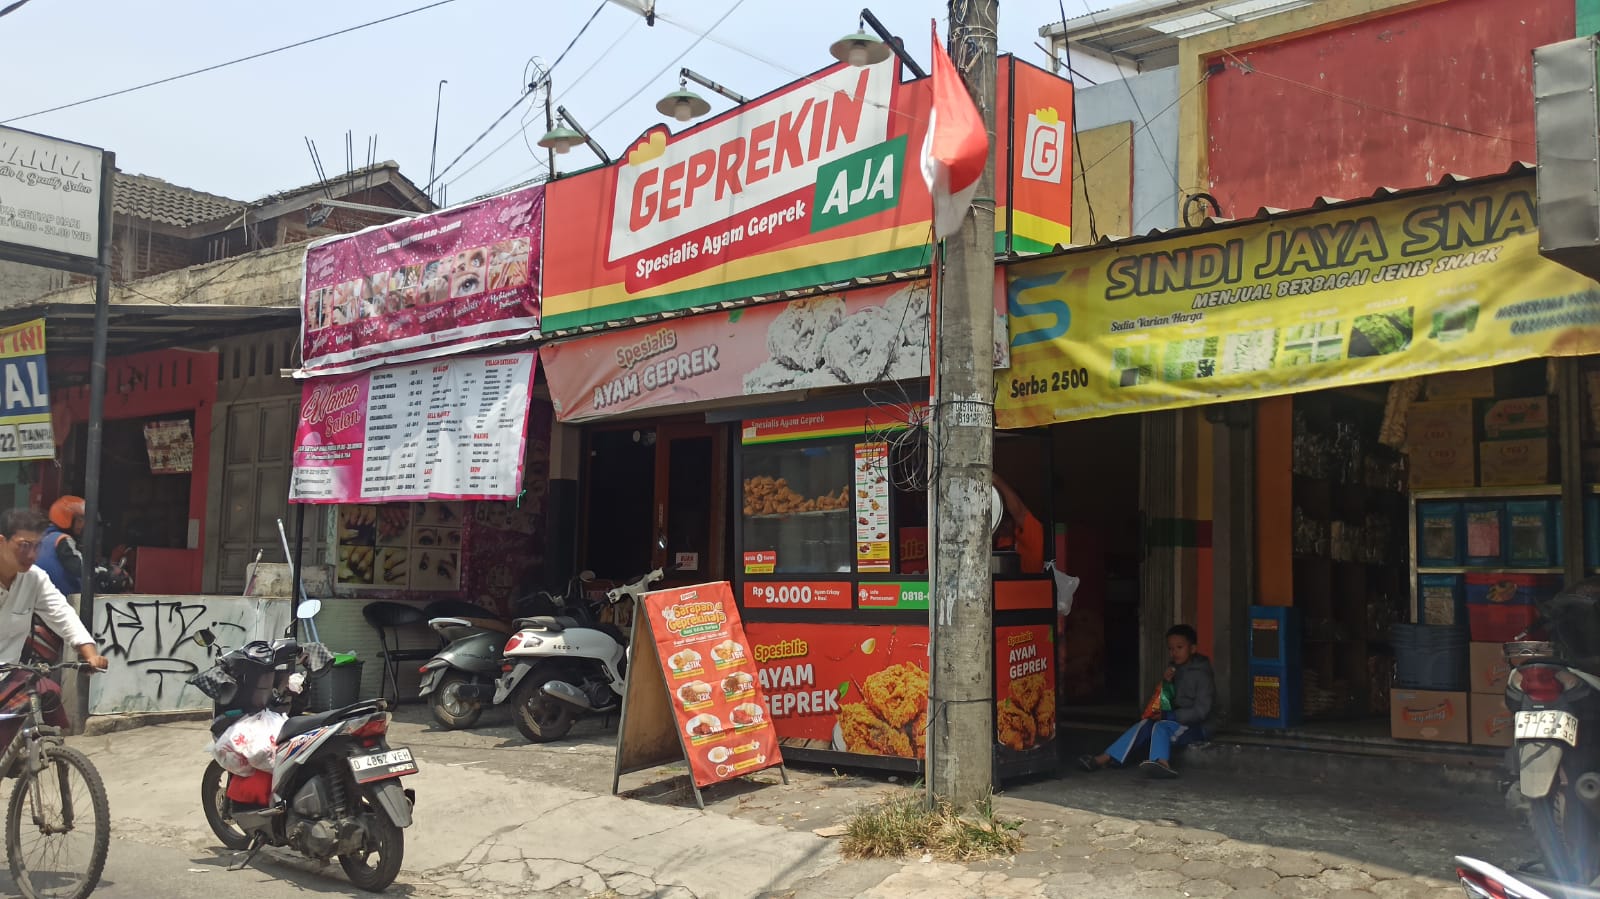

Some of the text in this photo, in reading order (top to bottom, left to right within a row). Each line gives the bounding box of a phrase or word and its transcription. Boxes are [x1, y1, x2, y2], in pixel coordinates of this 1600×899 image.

[629, 69, 870, 232] GEPREKIN
[821, 154, 894, 215] AJA
[635, 200, 806, 279] Spesialis Ayam Geprek
[1105, 190, 1540, 300] SINDI JAYA SNA
[1191, 246, 1503, 309] MENJUAL BERBAGAI JENIS SNACK
[1137, 316, 1169, 329] Varian
[1171, 311, 1203, 324] Harga
[616, 328, 677, 369] Spesialis
[0, 361, 48, 410] AL
[593, 344, 720, 409] AYAM GEPREK
[1010, 367, 1089, 398] Serba 2500
[325, 409, 361, 437] Salon
[779, 417, 799, 428] Ayam
[800, 413, 825, 425] Geprek
[752, 585, 812, 603] Rp 9.000
[673, 602, 713, 618] Sarapan
[754, 639, 808, 662] Spesialis
[1007, 630, 1033, 646] Spesialis
[1009, 644, 1037, 663] AYAM
[759, 663, 814, 689] AYAM
[1009, 657, 1048, 679] GEPREK
